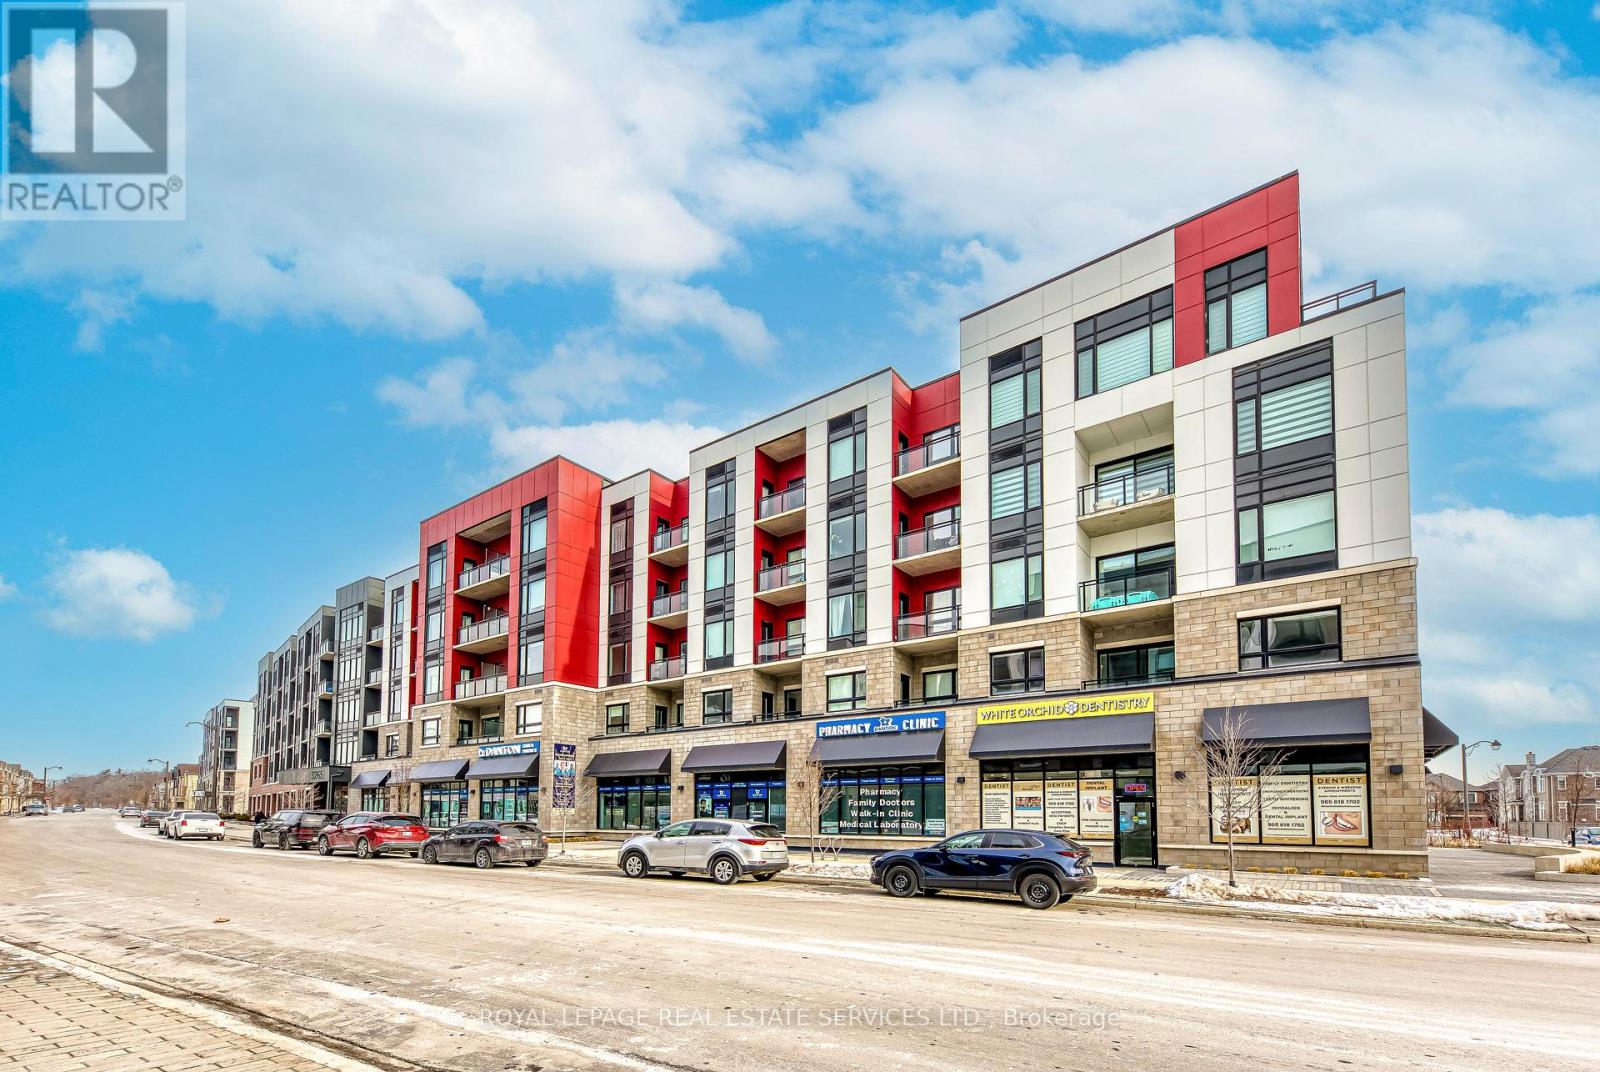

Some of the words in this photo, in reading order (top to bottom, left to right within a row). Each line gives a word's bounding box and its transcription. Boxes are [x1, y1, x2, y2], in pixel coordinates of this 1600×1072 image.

[980, 708, 1017, 721] WHITE
[1017, 704, 1064, 718] ORCHID
[1080, 697, 1151, 713] DENTISTRY
[818, 723, 871, 737] PHARMACY
[902, 717, 940, 731] CLINIC
[860, 788, 901, 796] Pharmacy
[848, 799, 876, 808] Family
[888, 809, 914, 817] Clinic
[839, 820, 873, 828] Medical
[874, 820, 922, 830] Laboratory
